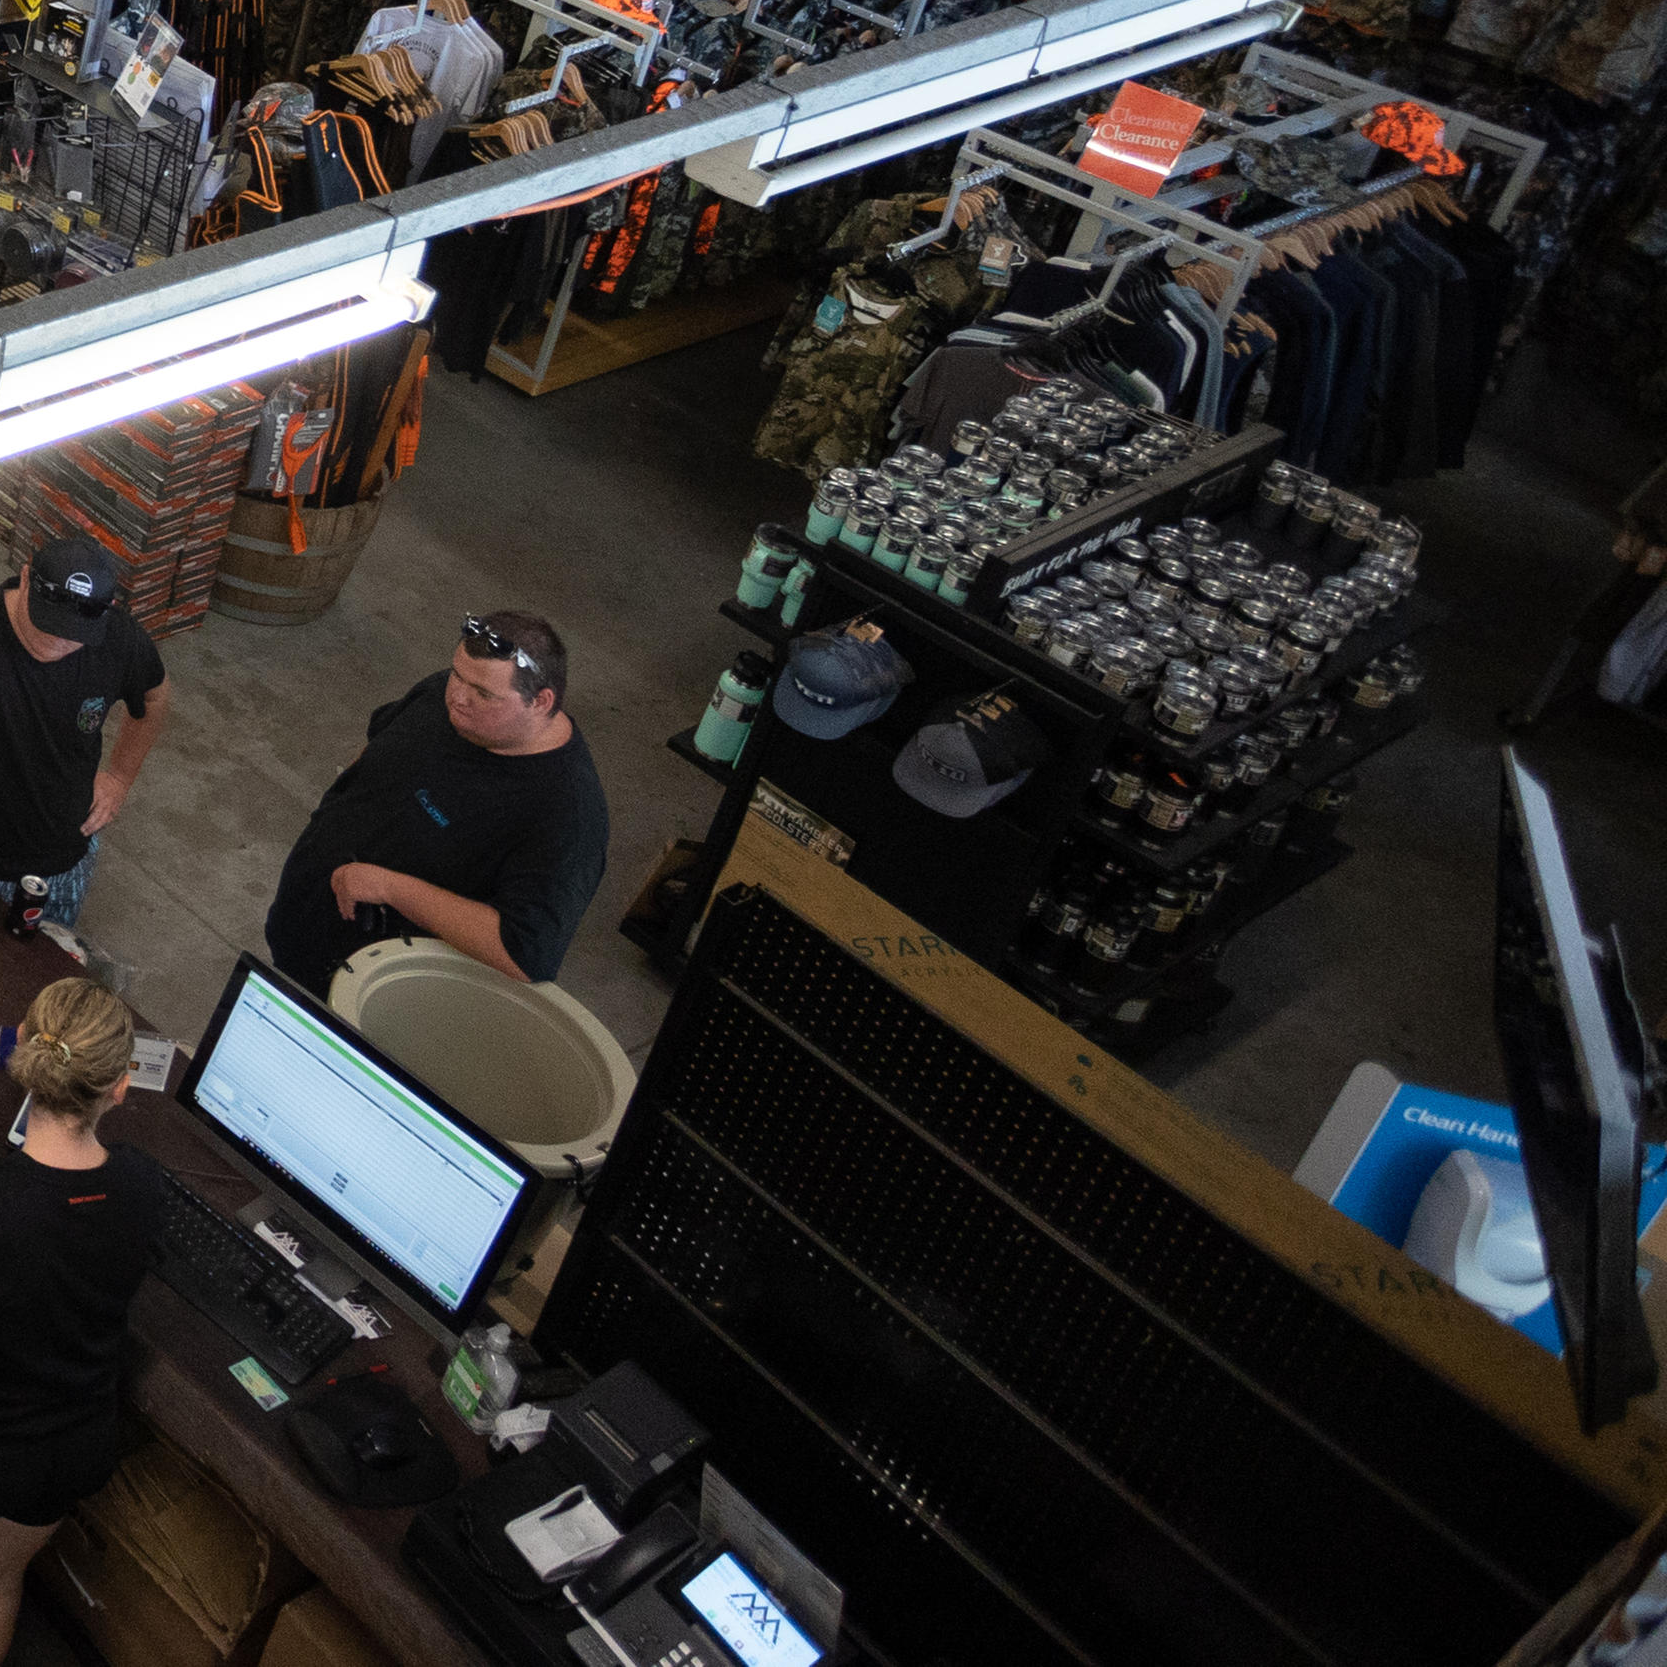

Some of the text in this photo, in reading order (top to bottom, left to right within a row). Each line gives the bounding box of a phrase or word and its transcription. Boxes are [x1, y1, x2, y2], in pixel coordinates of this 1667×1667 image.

[1099, 124, 1180, 151] Clearance
[755, 788, 845, 855] YETI RAMBLER
[1403, 1107, 1467, 1135] Clean
